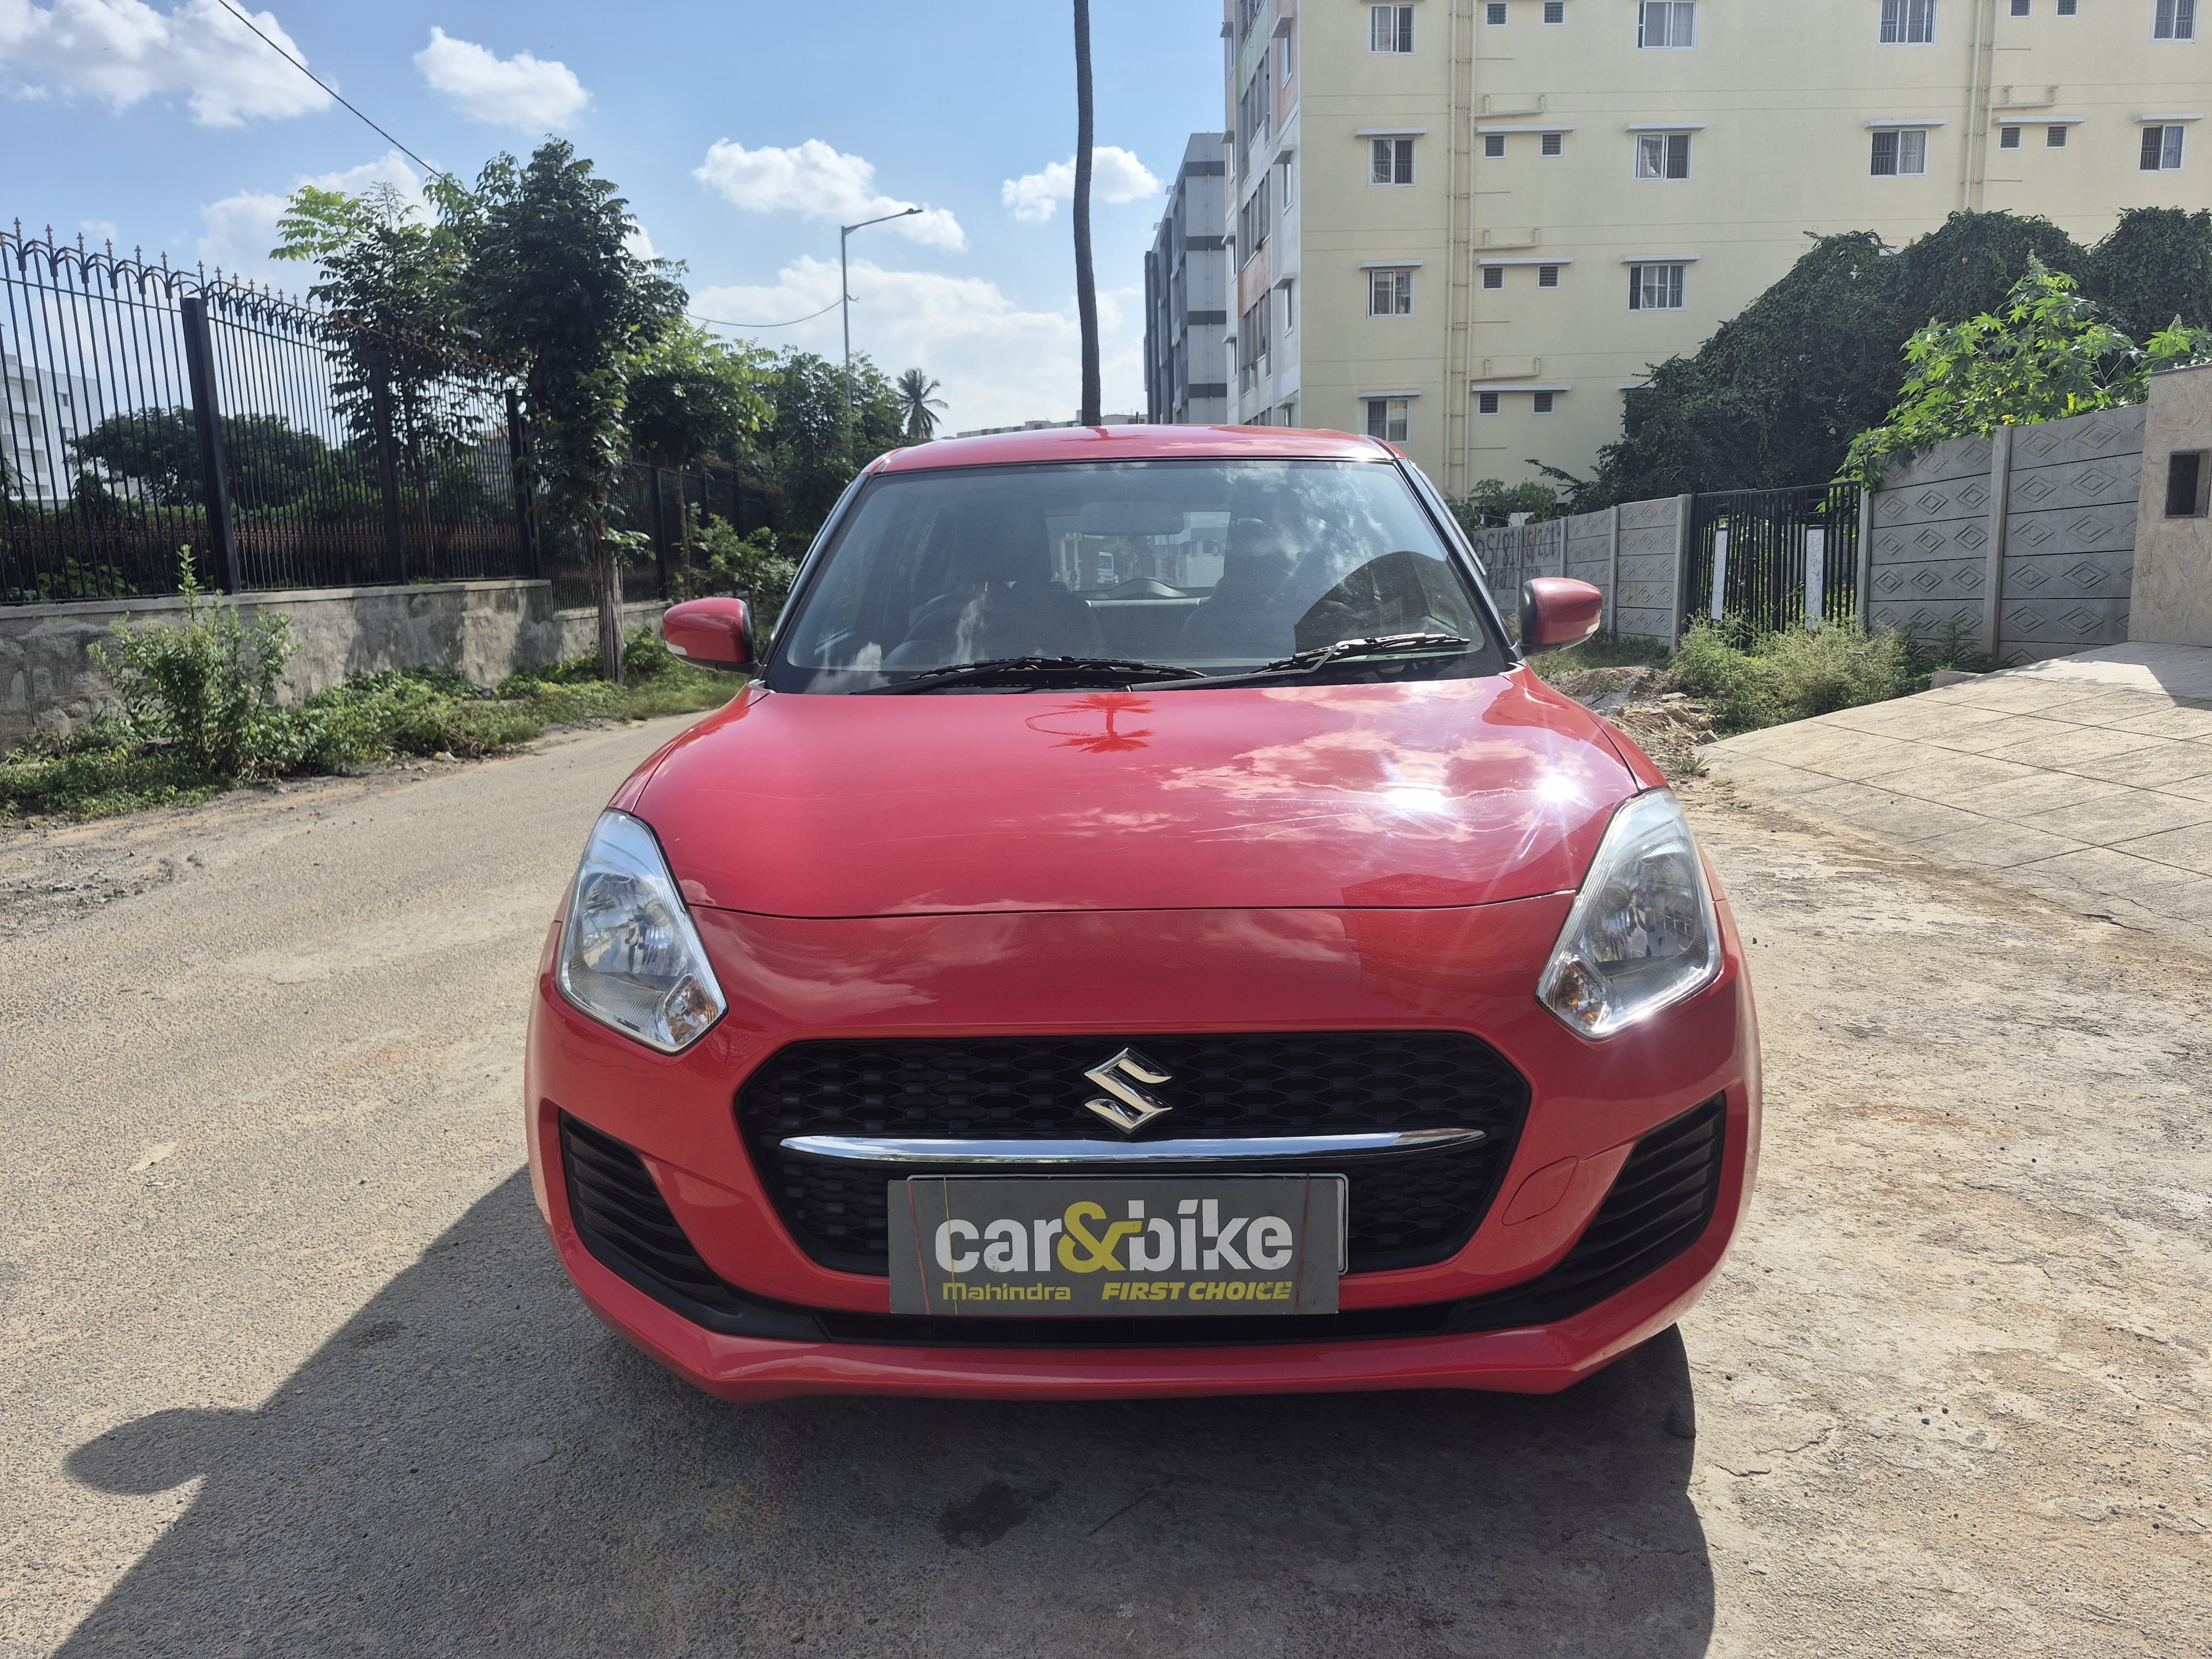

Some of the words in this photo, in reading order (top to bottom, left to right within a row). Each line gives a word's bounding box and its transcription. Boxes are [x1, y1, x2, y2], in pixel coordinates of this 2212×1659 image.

[935, 1199, 1293, 1274] car&bike
[942, 1282, 1071, 1300] Mahindra
[1102, 1282, 1186, 1300] FIRST
[1187, 1281, 1293, 1300] CHOICE
